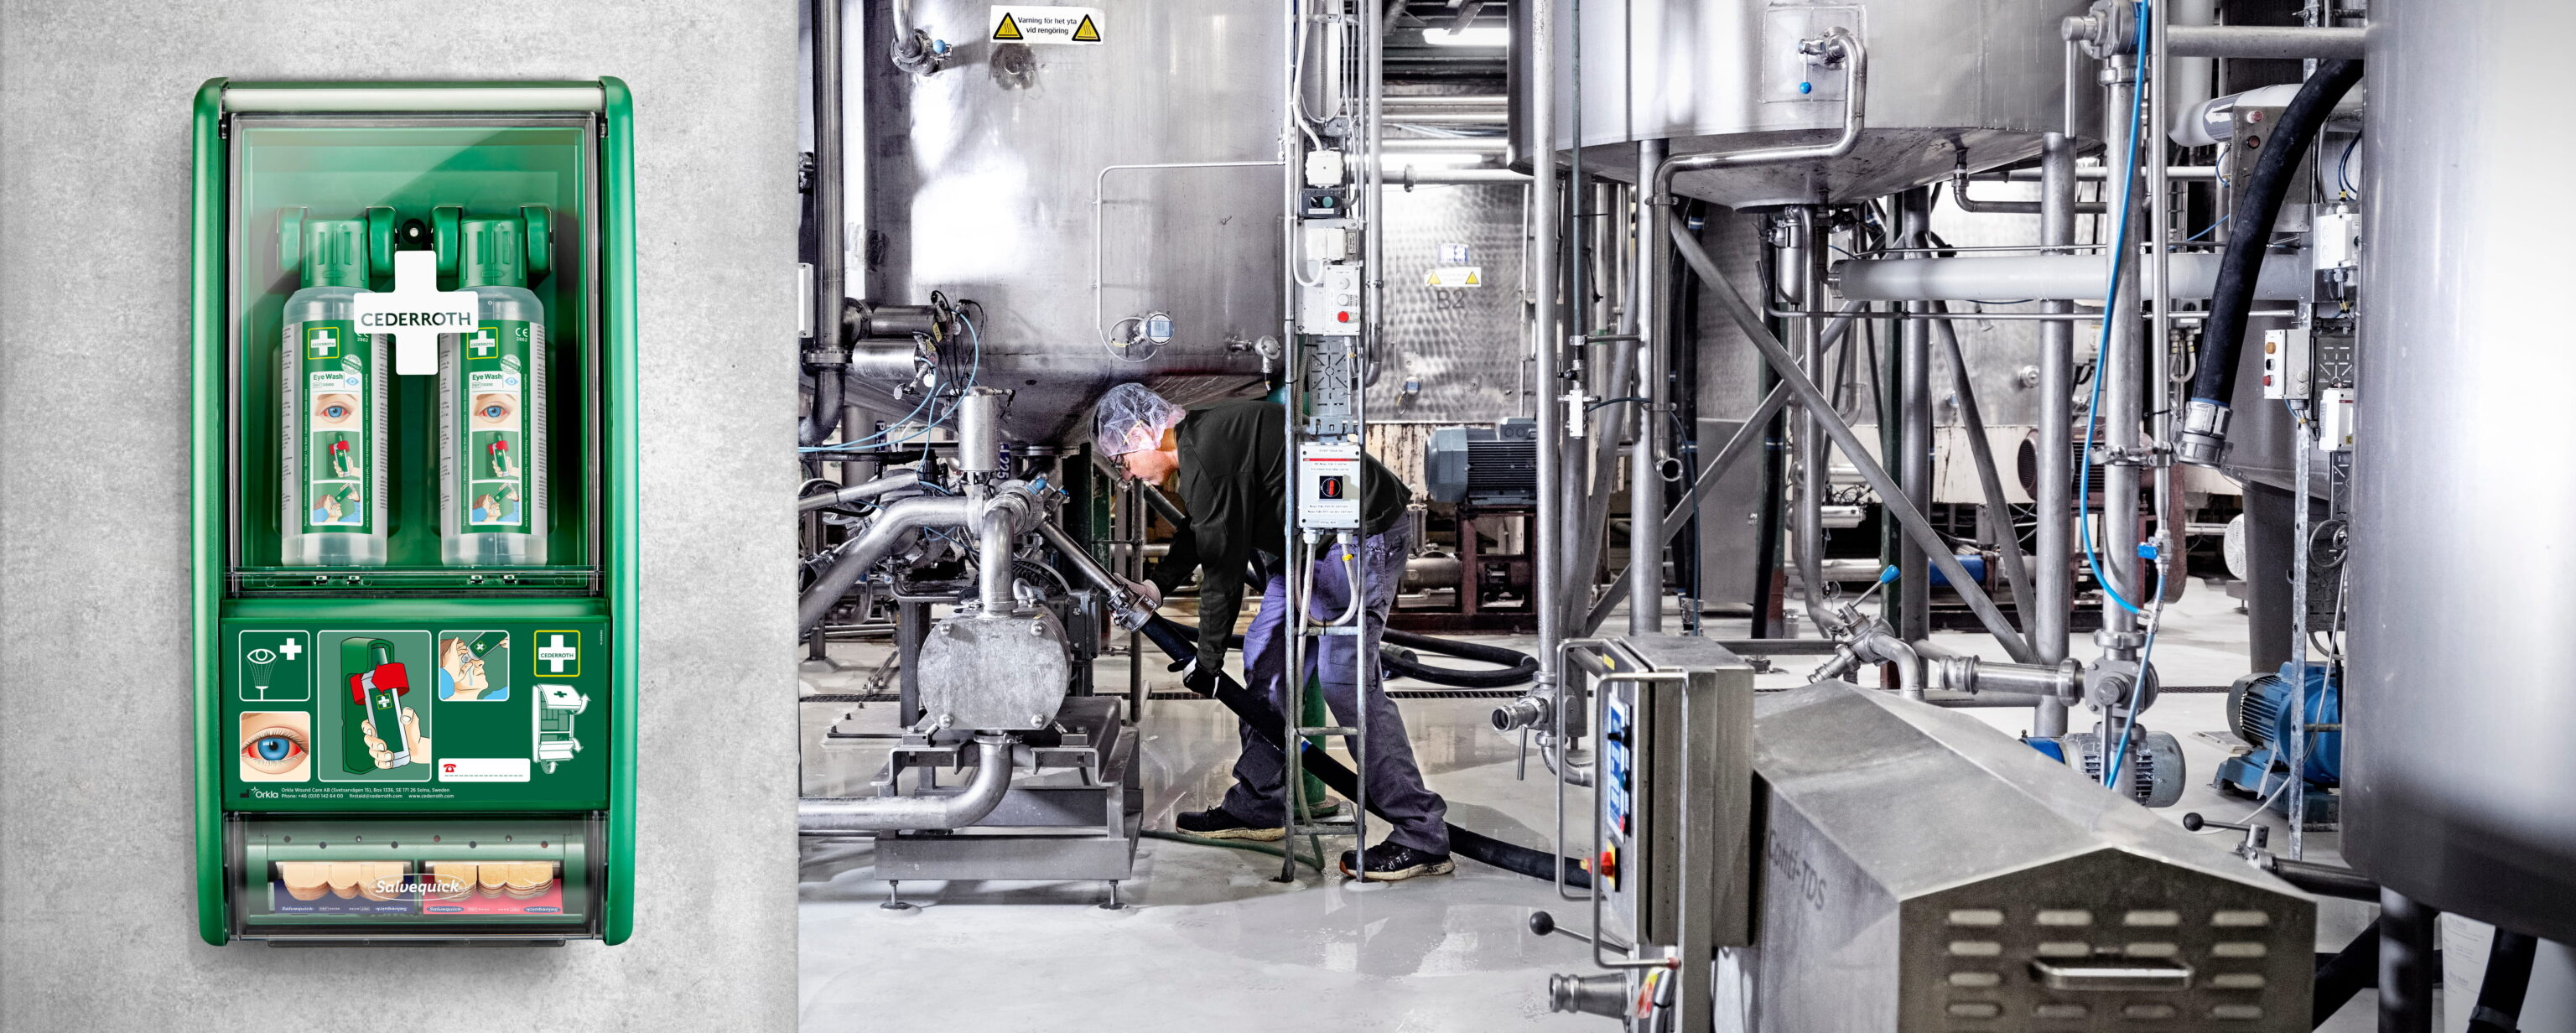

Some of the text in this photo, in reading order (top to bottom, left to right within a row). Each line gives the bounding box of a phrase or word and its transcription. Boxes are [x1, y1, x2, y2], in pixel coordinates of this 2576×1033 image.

[1037, 27, 1069, 35] rengöring
[1436, 289, 1465, 309] B2
[361, 312, 471, 326] CEDERROTH
[255, 791, 279, 799] Orkla
[1768, 828, 1827, 911] Conti-TDS
[375, 880, 460, 896] Salvequick
